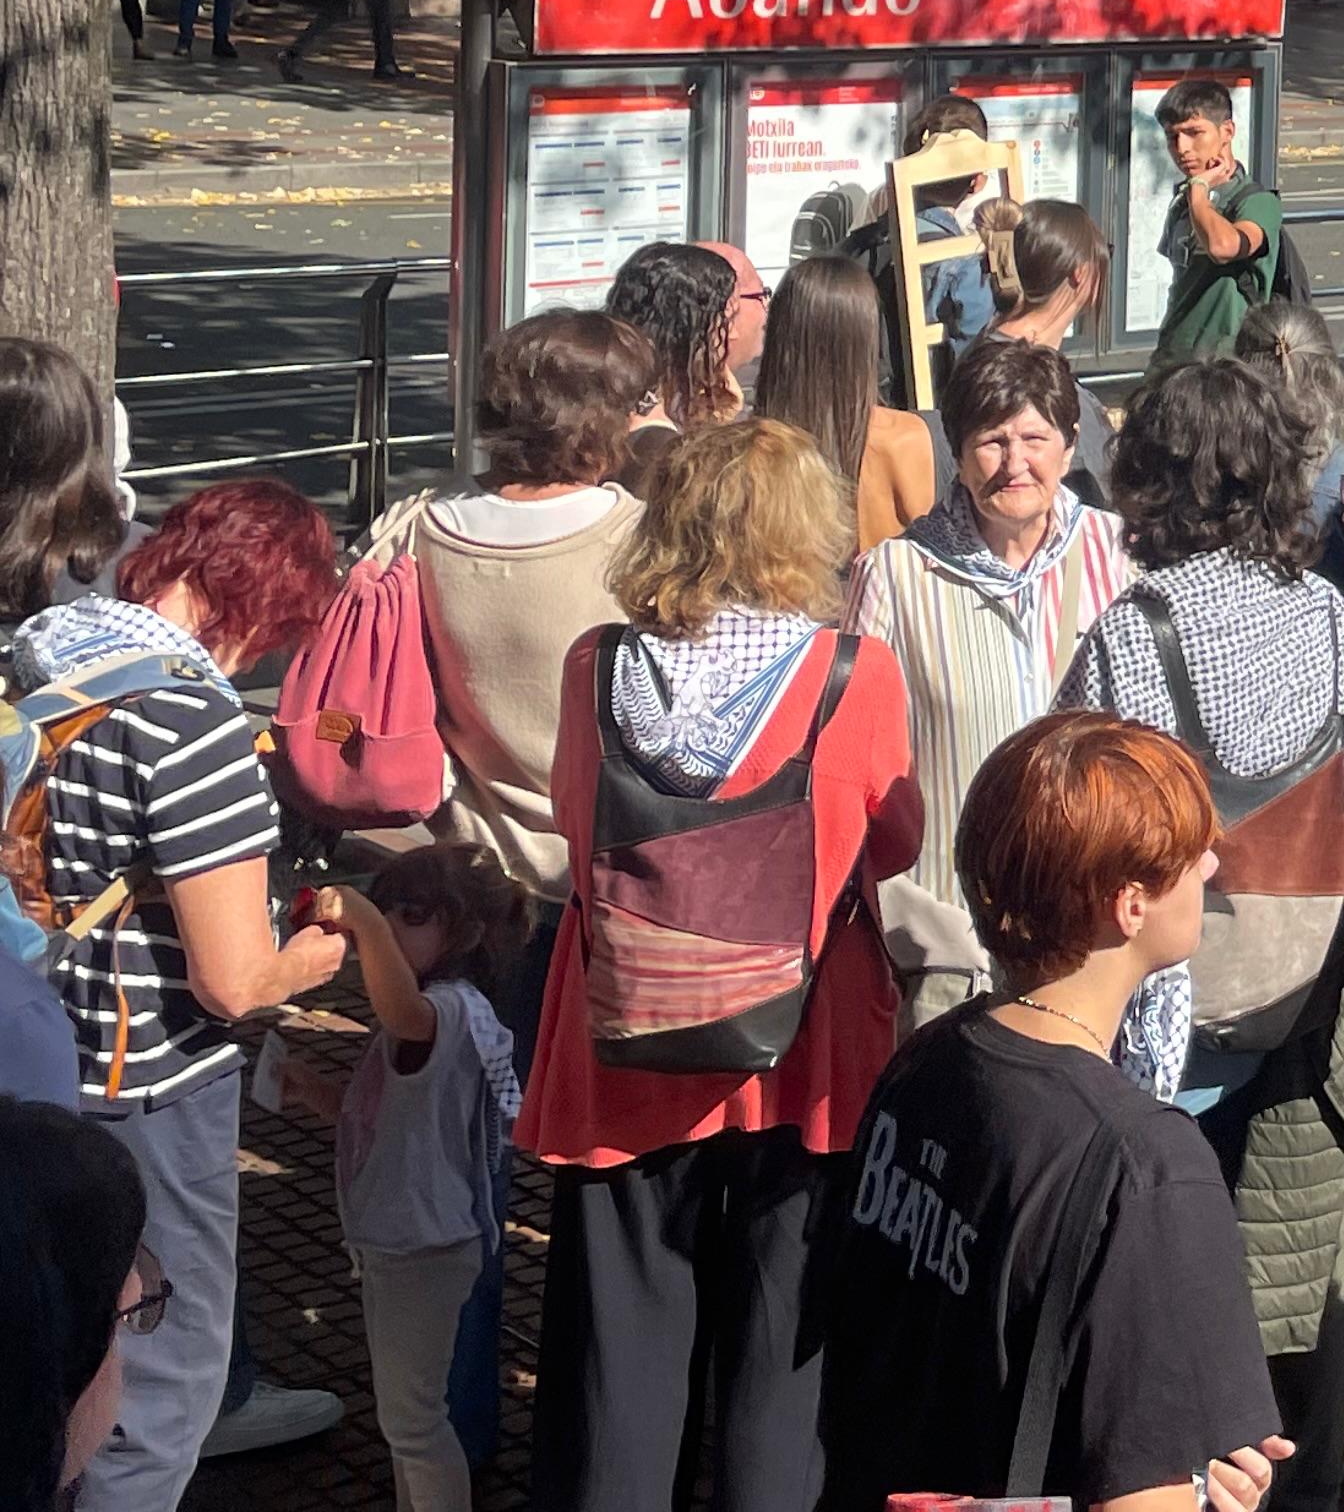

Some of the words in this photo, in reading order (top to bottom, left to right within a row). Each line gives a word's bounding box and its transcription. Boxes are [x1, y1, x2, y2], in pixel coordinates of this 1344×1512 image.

[748, 118, 795, 138] Motxila
[919, 1138, 949, 1180] THE
[852, 1109, 979, 1296] BEATLES
